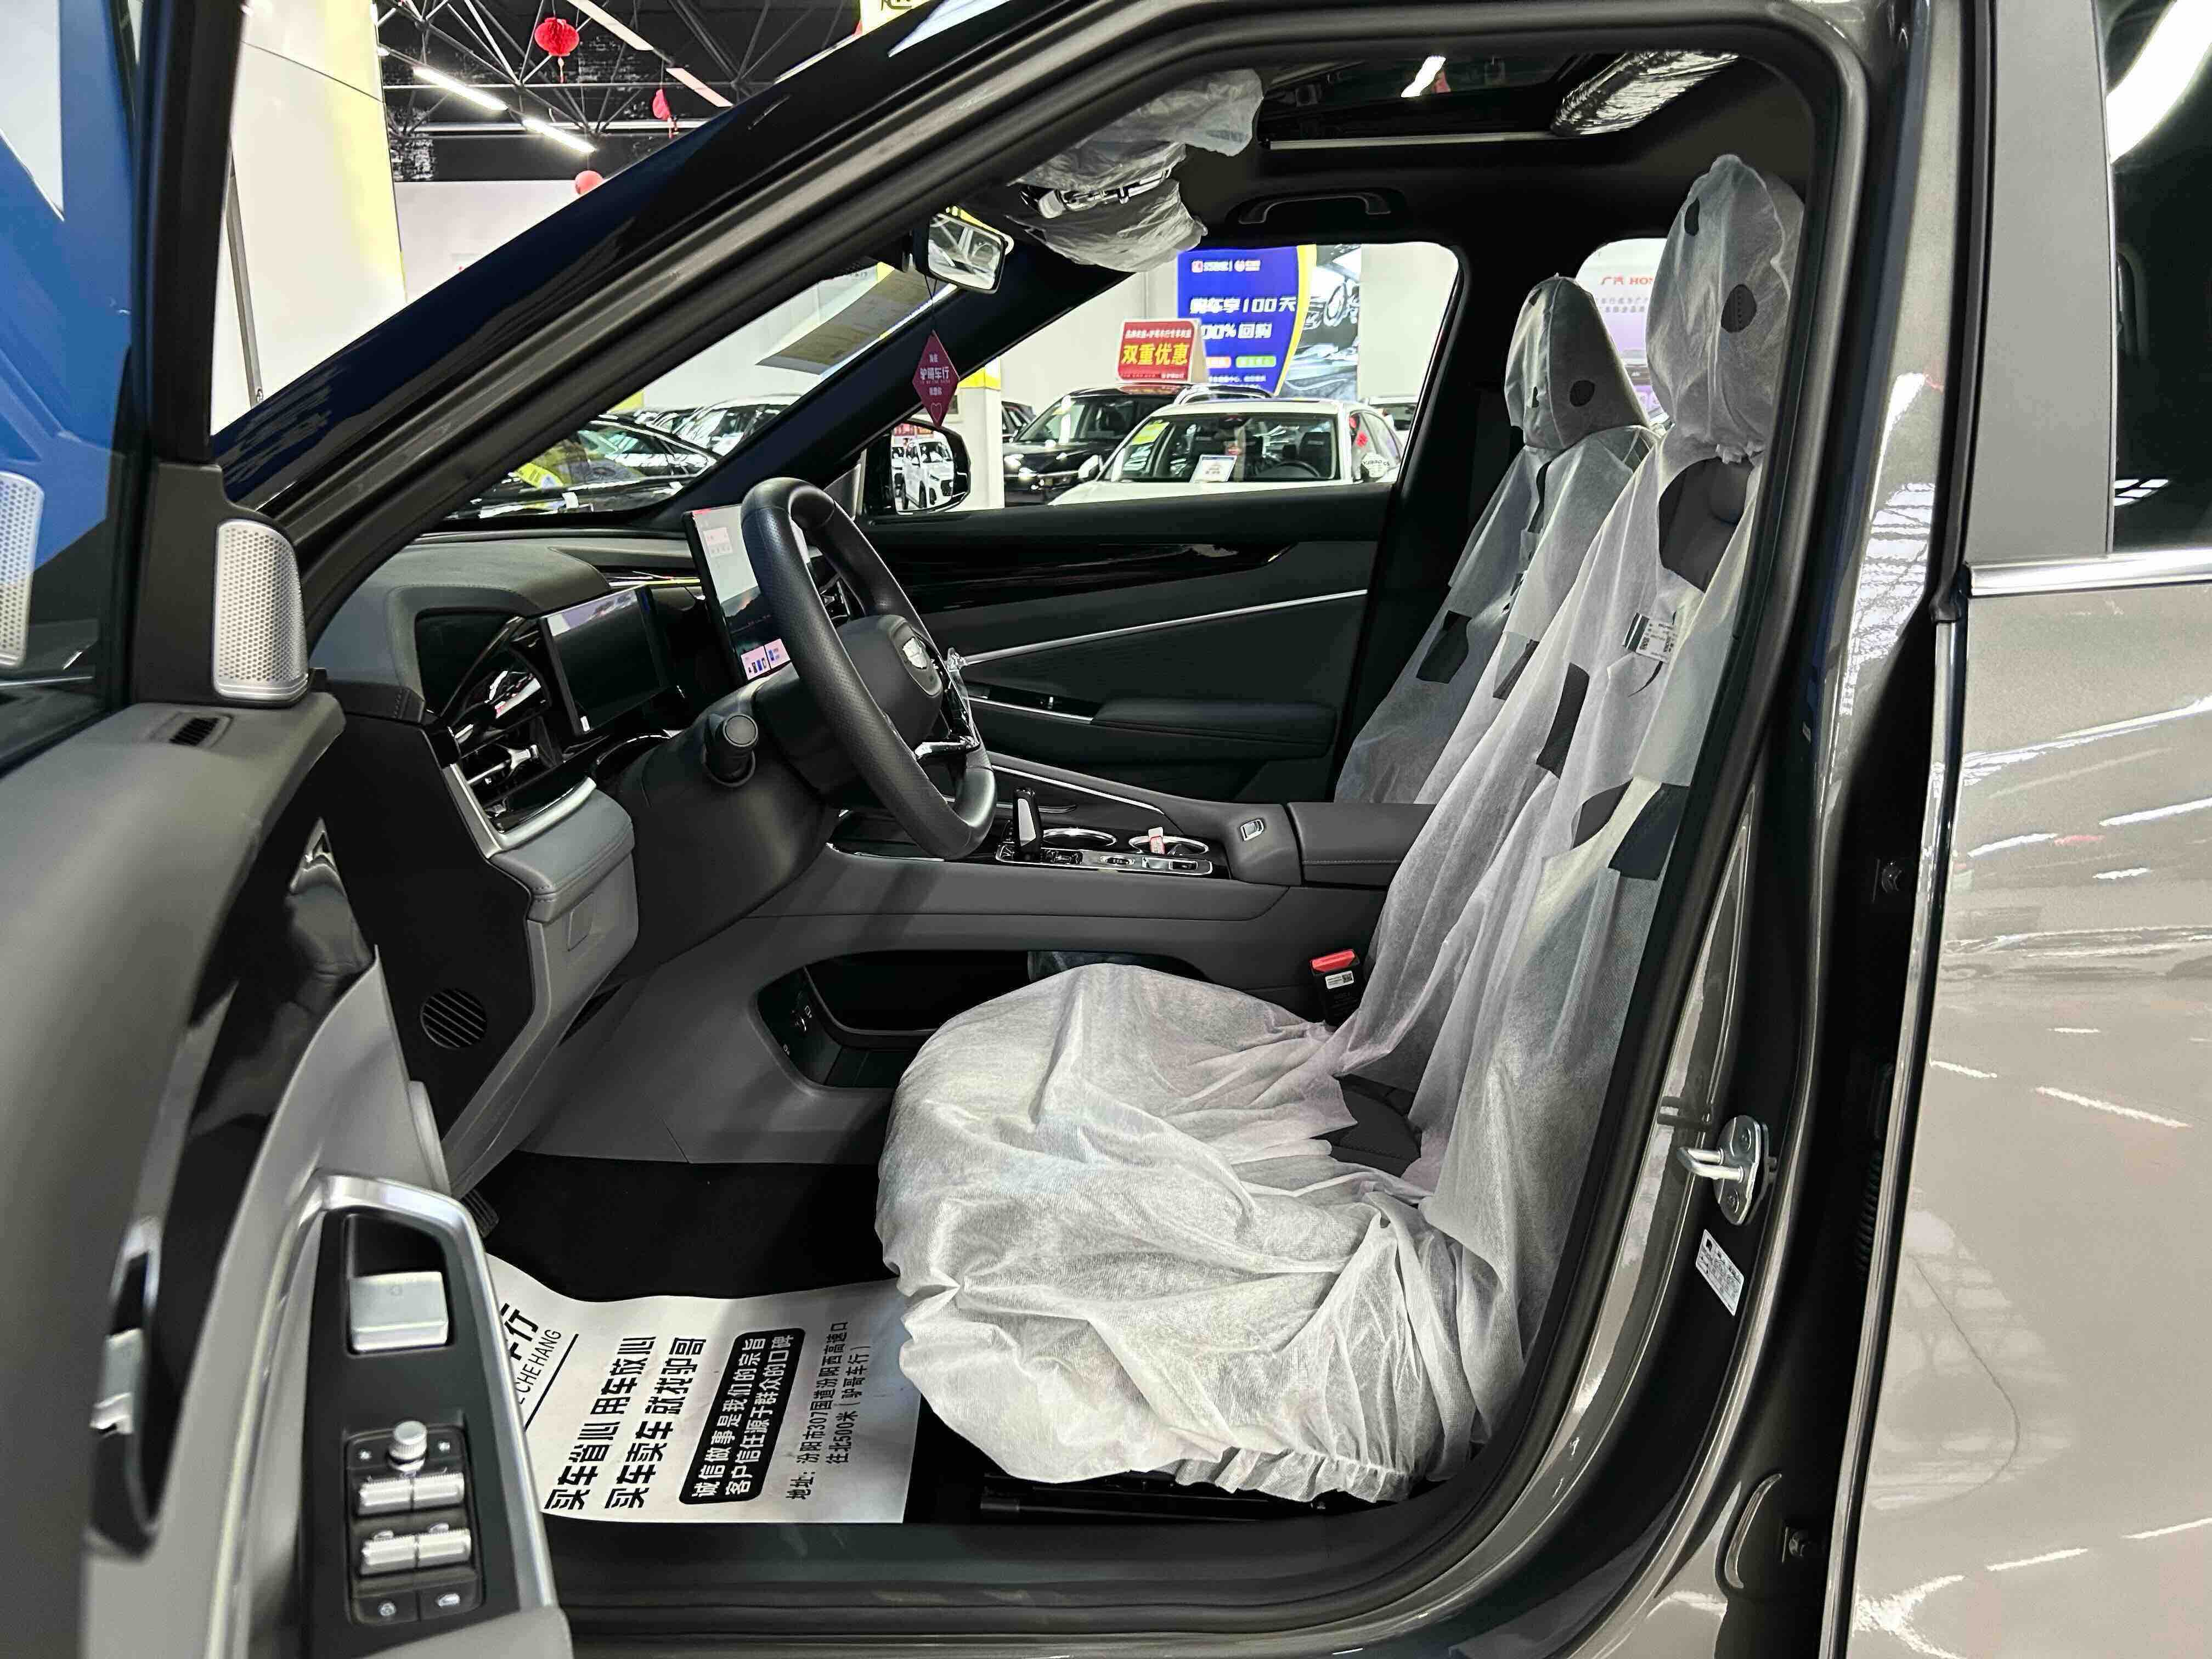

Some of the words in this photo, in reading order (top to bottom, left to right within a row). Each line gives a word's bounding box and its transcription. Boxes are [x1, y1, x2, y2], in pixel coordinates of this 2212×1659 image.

[1121, 342, 1189, 365] 双重优惠
[1201, 323, 1272, 340] 00%回购
[534, 1329, 562, 1368] HANG
[544, 1421, 620, 1510] 买车省心
[590, 1336, 656, 1415] 用车放心
[604, 1421, 673, 1509] 买车卖车
[645, 1336, 707, 1415] 就找驴哥
[691, 1338, 766, 1498] 诚信做事是我们的宗旨
[725, 1334, 794, 1496] 客户信任源于群众的口碑
